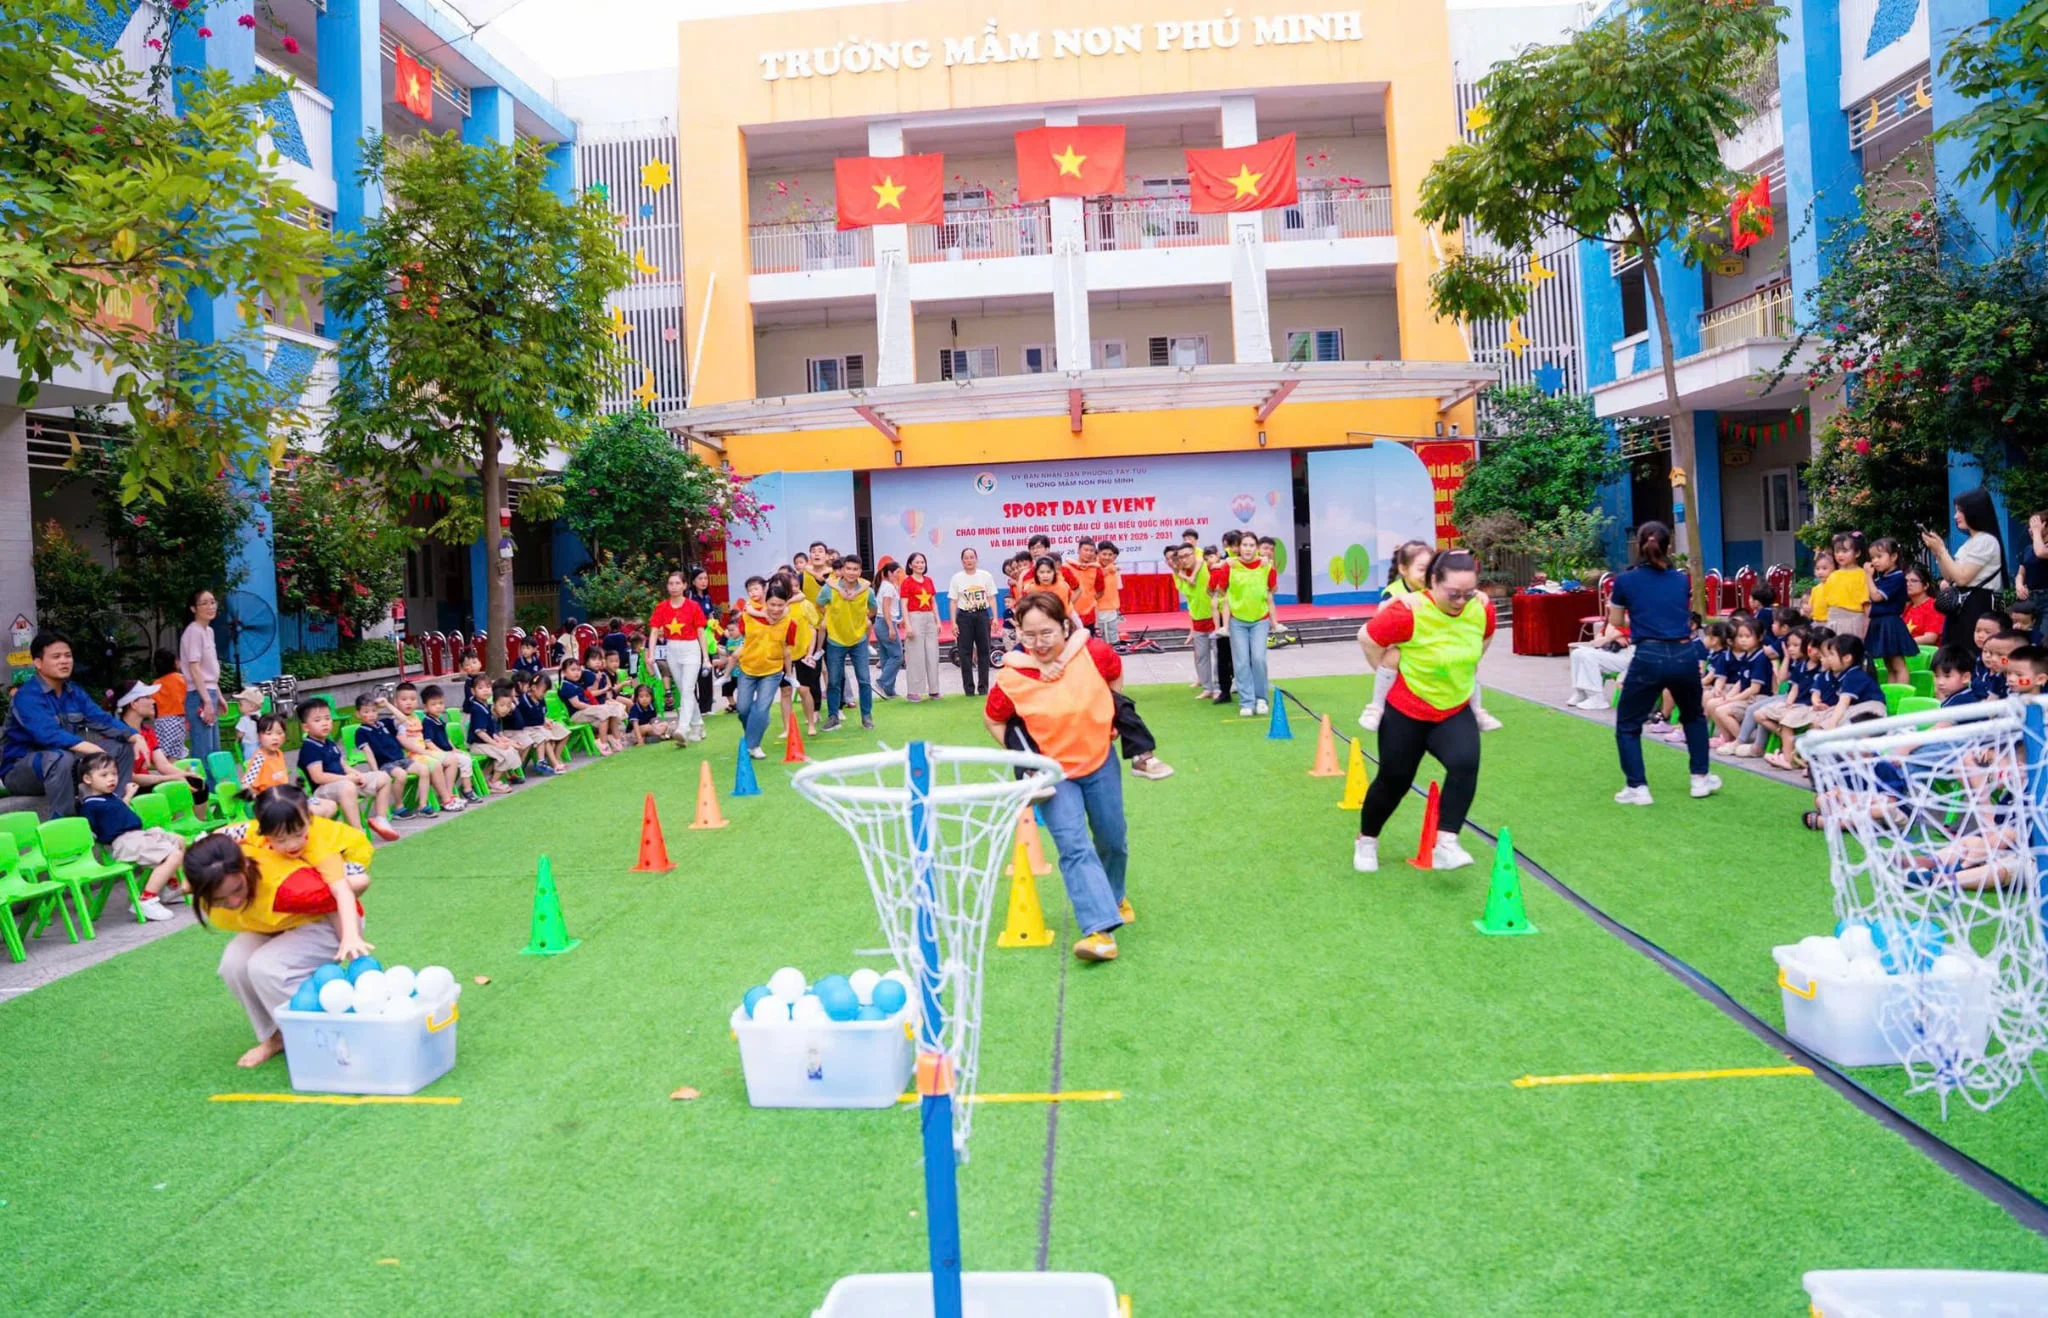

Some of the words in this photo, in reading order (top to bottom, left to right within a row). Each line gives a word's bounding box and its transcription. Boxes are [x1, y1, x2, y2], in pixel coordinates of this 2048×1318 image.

[760, 36, 932, 81] TRƯỜNG
[944, 16, 1041, 66] MẦM
[1052, 23, 1144, 59] NON
[1253, 10, 1364, 46] MINH
[1114, 477, 1134, 485] MINH
[1003, 501, 1059, 518] SPORT
[1062, 499, 1097, 515] DAY
[1102, 496, 1156, 513] EVENT
[1197, 517, 1209, 525] XVI
[1156, 531, 1173, 540] 2031
